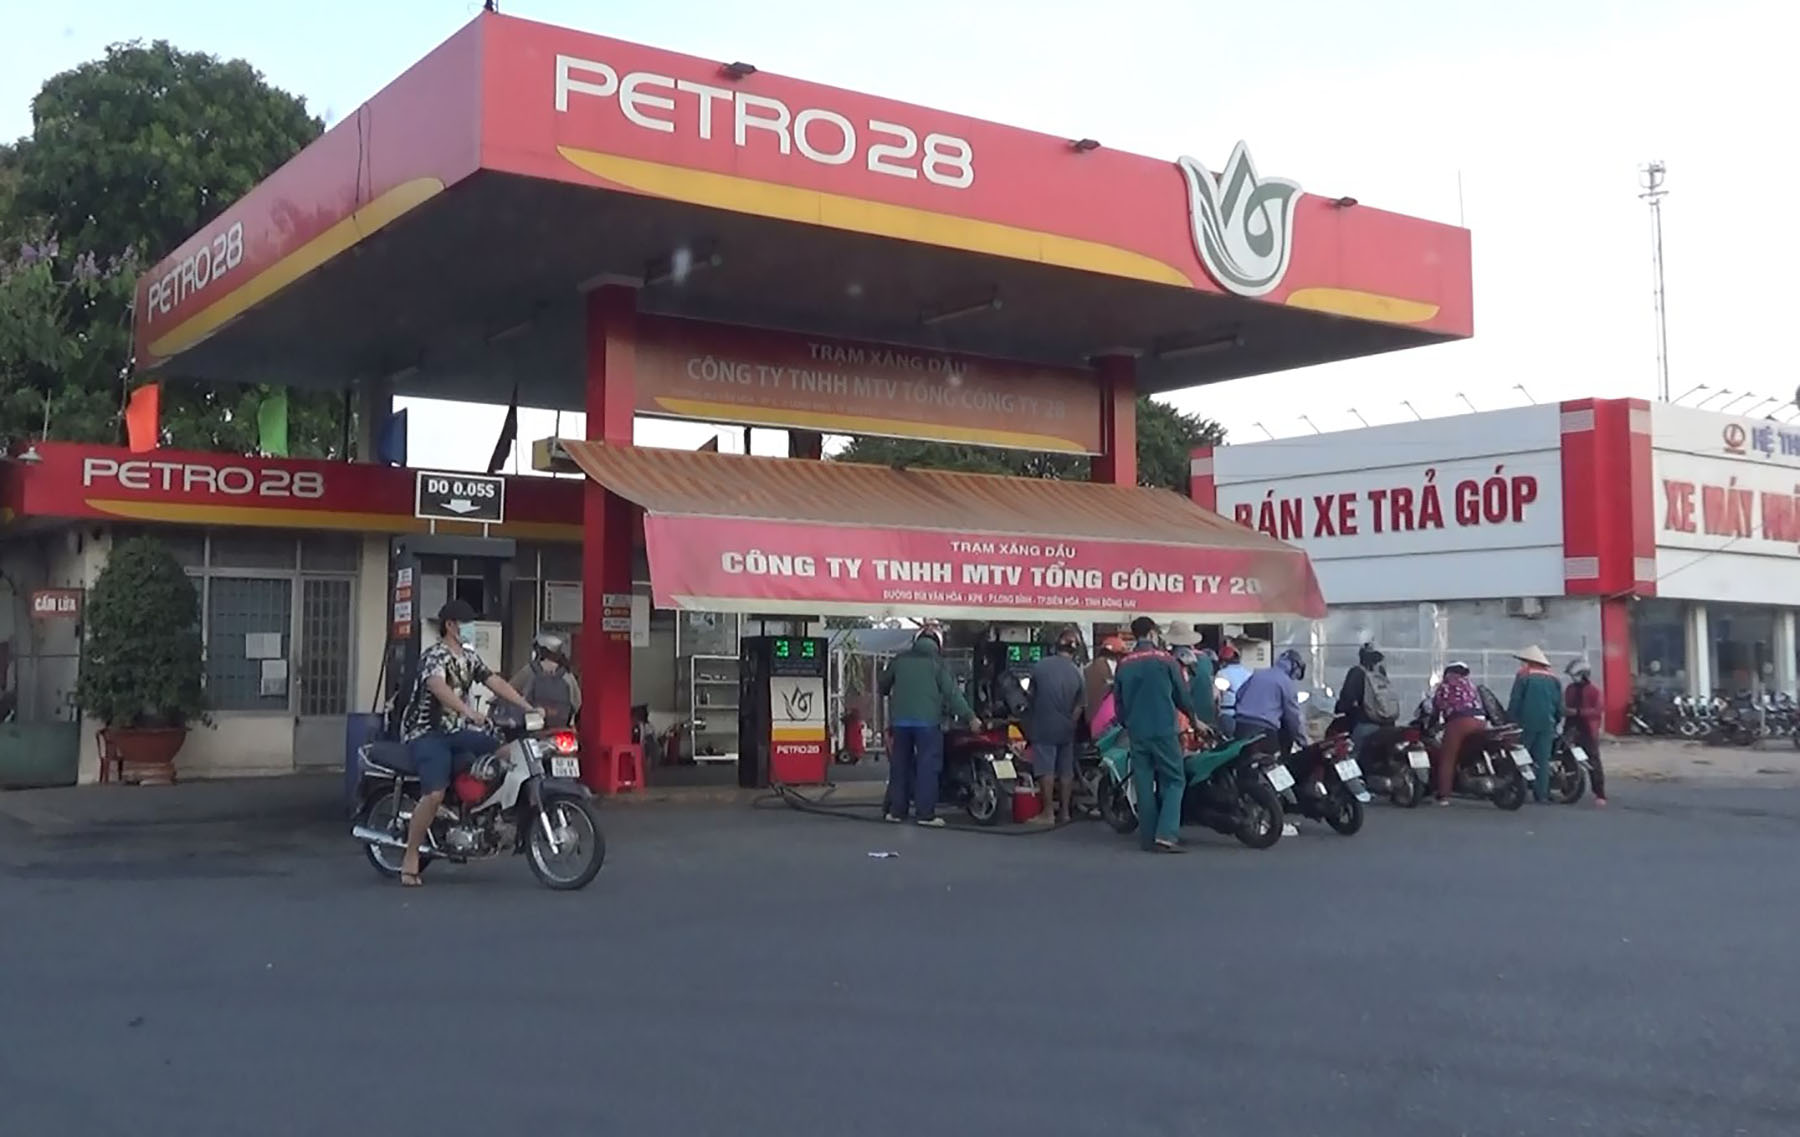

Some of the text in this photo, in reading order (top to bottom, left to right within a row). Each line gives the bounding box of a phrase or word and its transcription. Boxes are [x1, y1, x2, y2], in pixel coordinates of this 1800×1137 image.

[687, 354, 751, 385] CÔNG
[757, 365, 786, 388] TY
[788, 368, 849, 394] TNHH
[854, 375, 897, 400] MTV
[428, 479, 495, 498] DO 0.05S
[1313, 492, 1358, 538] XE
[1368, 467, 1445, 533] TRẢ
[1455, 464, 1538, 527] GÓP
[1661, 479, 1696, 533] XE
[950, 541, 994, 555] TRẠM
[1000, 543, 1040, 556] XĂNG
[721, 549, 816, 577] CÔNG
[826, 557, 863, 579] TY
[872, 559, 952, 583] TNHH
[962, 563, 1022, 587] MTV
[1112, 567, 1184, 593] CÔNG
[1192, 574, 1222, 595] TY
